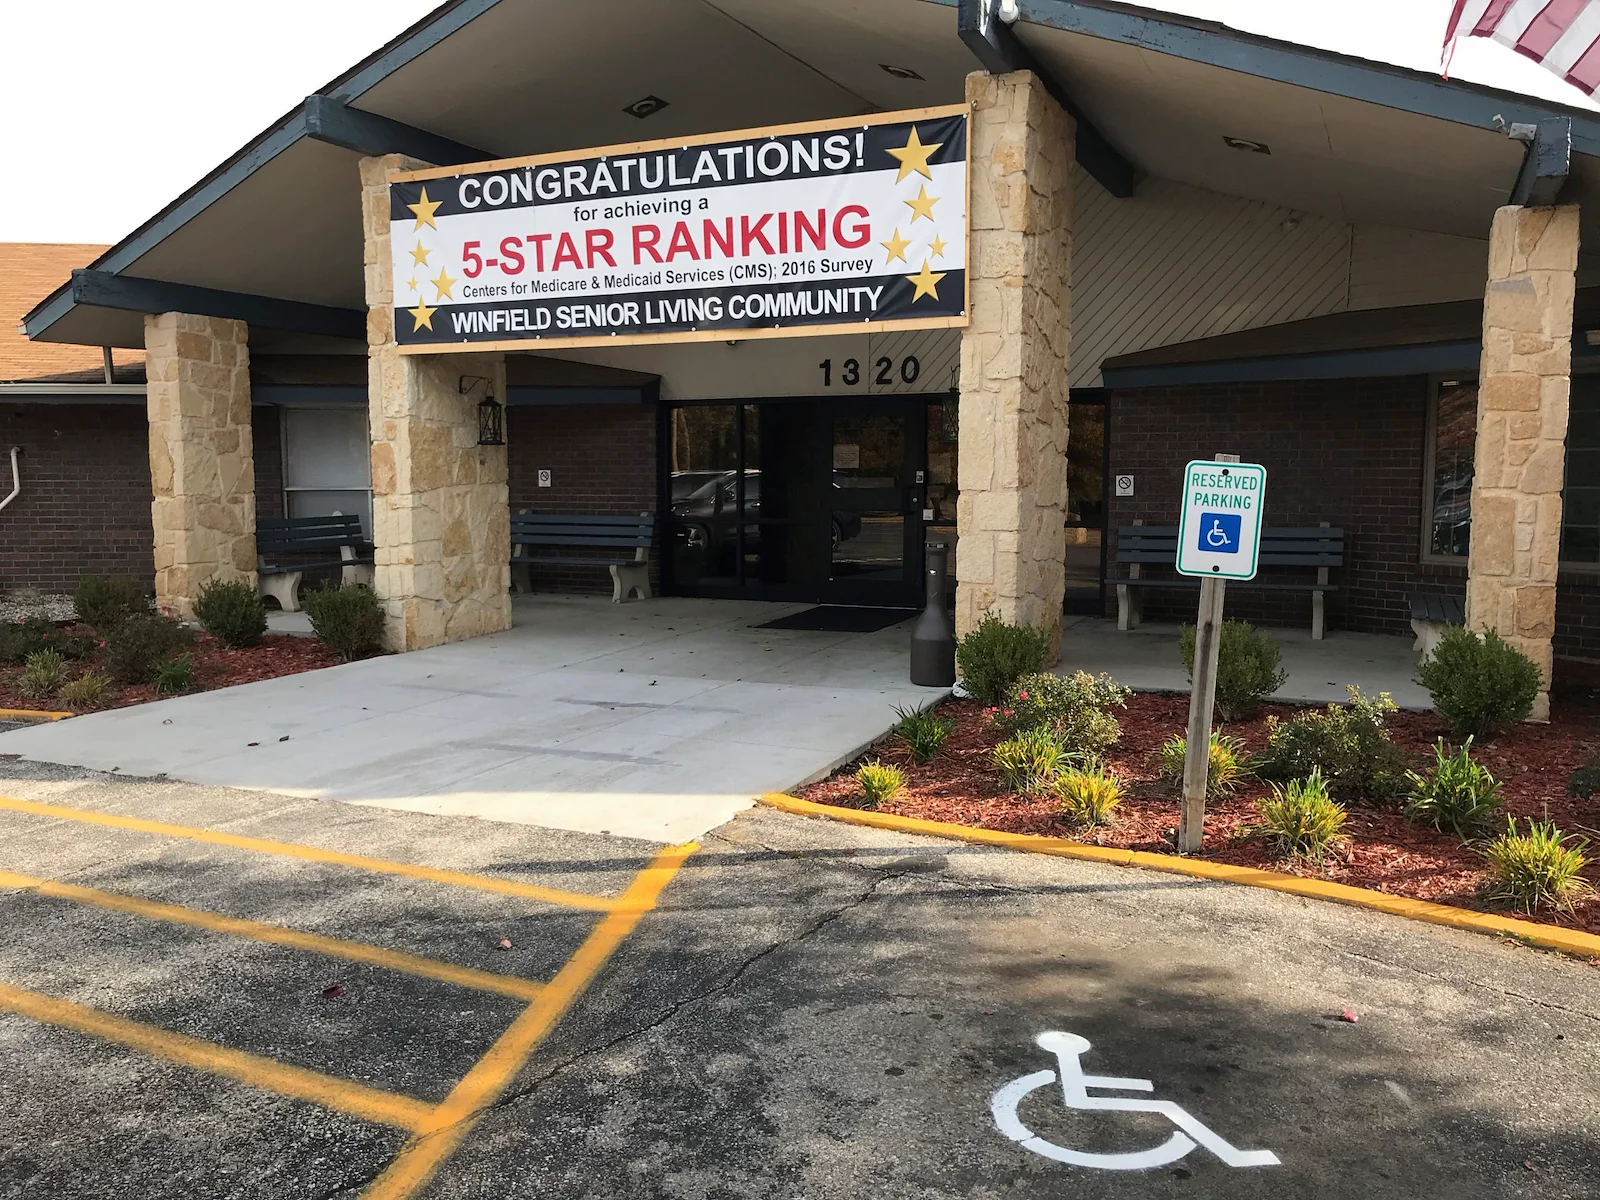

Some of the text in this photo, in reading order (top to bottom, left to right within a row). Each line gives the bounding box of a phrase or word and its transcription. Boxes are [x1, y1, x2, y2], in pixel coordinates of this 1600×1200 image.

[458, 132, 866, 209] CONGRATULATIONS!
[573, 197, 708, 221] for achieving a
[461, 204, 872, 278] 5-STAR RANKING
[462, 257, 874, 298] Centers for Medicare & Medicaid Services (CMS); 2016 Survey
[451, 284, 884, 334] WINFIELD SENIOR LIVING COMMUNITY
[819, 355, 920, 387] 1320
[1192, 473, 1258, 490] RESERVED
[1194, 492, 1252, 509] PARKING
